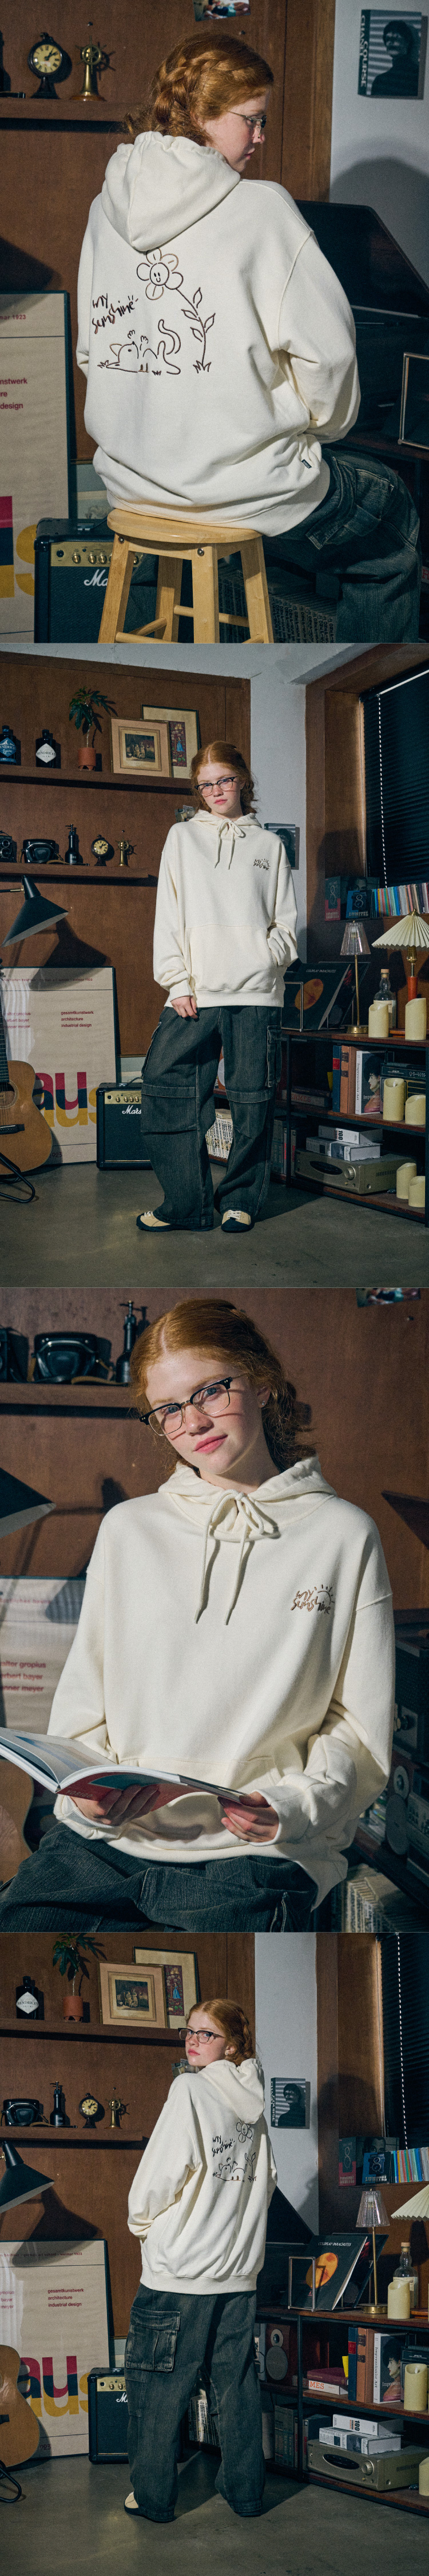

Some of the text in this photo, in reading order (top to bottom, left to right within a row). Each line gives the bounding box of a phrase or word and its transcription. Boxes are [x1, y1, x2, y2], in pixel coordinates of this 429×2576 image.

[93, 293, 108, 309] my
[92, 300, 135, 334] sunshine
[0, 402, 23, 410] design
[296, 1589, 314, 1601] my
[291, 1595, 331, 1615] sunshine
[23, 1673, 43, 1681] bayer
[213, 2135, 221, 2144] my
[212, 2140, 233, 2157] sunshine
